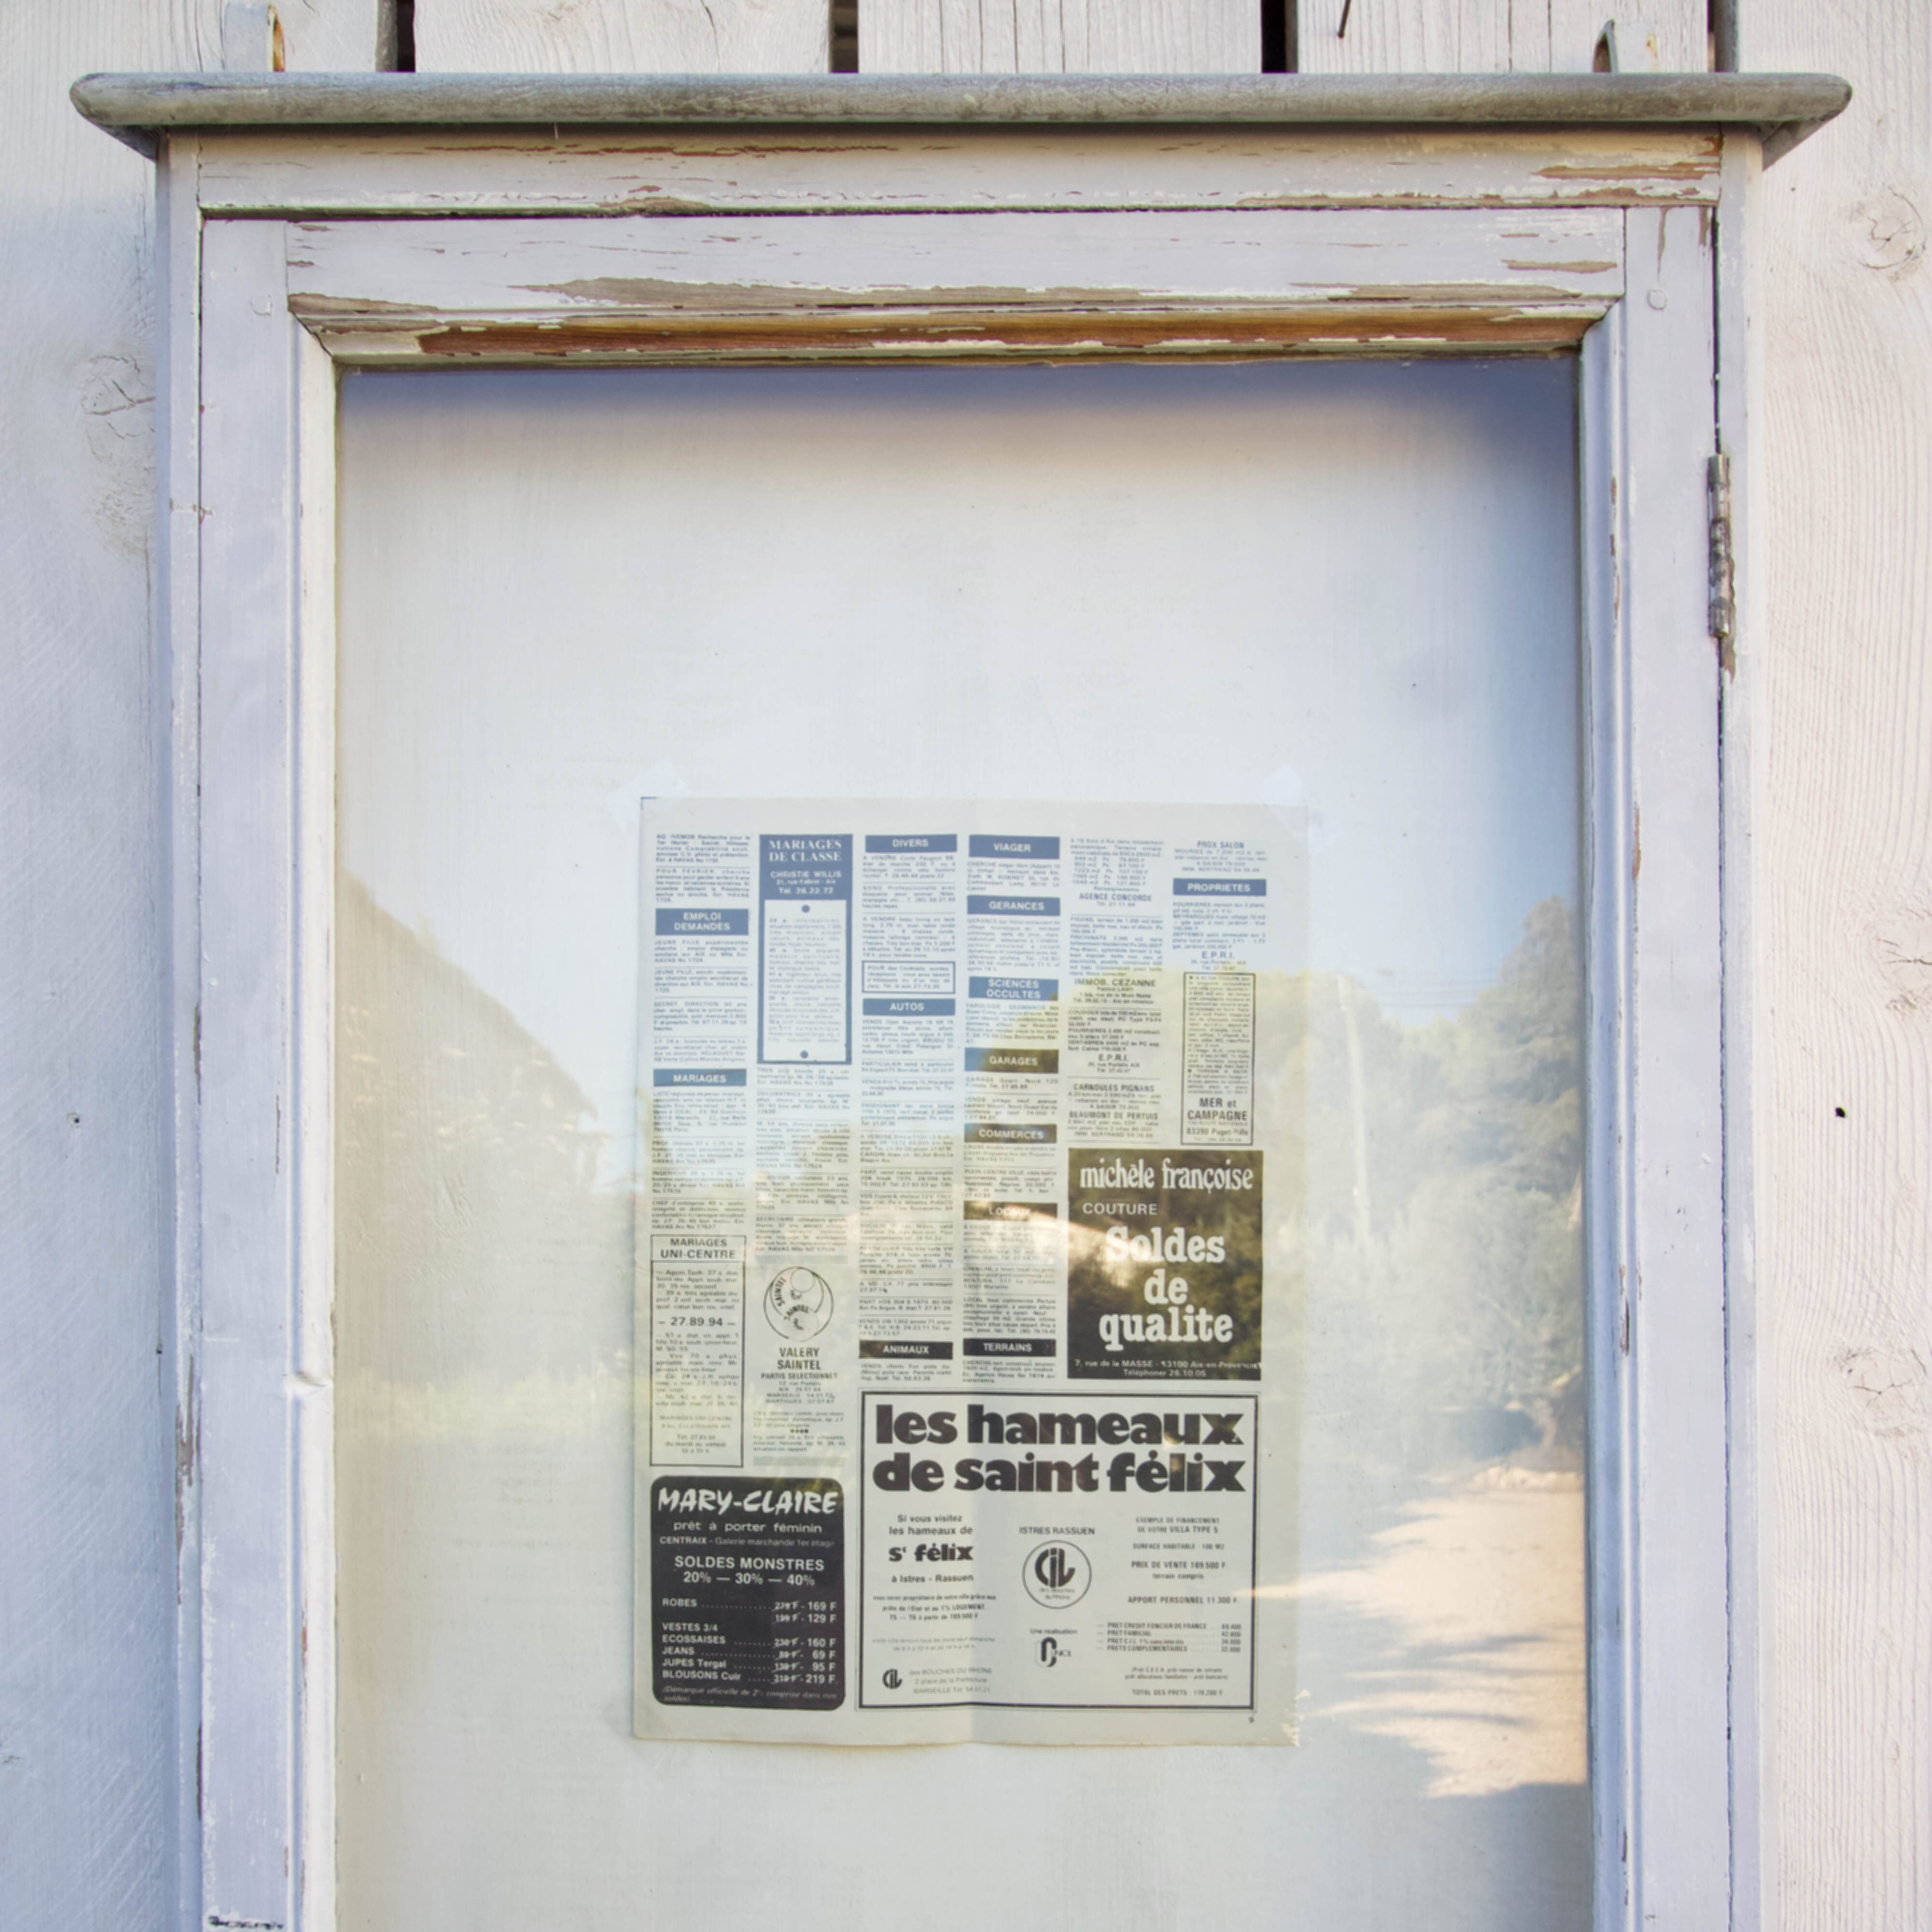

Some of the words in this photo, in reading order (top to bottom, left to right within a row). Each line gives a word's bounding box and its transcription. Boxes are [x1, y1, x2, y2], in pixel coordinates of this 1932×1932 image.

[769, 839, 842, 850] MARIAGES
[892, 839, 928, 848] DIVERS
[994, 843, 1031, 852] VIAGER
[769, 852, 788, 862] DE
[791, 851, 842, 862] CLASSE
[1187, 883, 1250, 893] PROPRIETES
[989, 901, 1044, 910] GERANCES
[683, 912, 722, 921] EMPLOI
[674, 922, 730, 931] DEMANDES
[988, 979, 1039, 989] SCIENCES
[1112, 979, 1156, 987] CEZANNE
[986, 989, 1041, 999] OCCULTES
[890, 1002, 924, 1011] AUTOS
[989, 1055, 1038, 1066] GARAGES
[673, 1074, 726, 1083] MARIAGES
[1199, 1098, 1223, 1108] MER
[1227, 1099, 1236, 1108] et
[1187, 1110, 1248, 1121] CAMPAGNE
[979, 1129, 1044, 1139] COMMERCES
[1080, 1158, 1155, 1188] michèle
[1161, 1157, 1253, 1193] françoise
[1082, 1202, 1158, 1215] COUTURE
[670, 1238, 727, 1247] MARIAGES
[1106, 1225, 1226, 1263] Soldes
[660, 1249, 736, 1259] UNI-CENTRE
[1143, 1268, 1189, 1305] de
[670, 1317, 723, 1327] 27.89.94
[1098, 1304, 1233, 1351] qualite
[883, 1345, 930, 1355] ANIMAUX
[982, 1342, 1032, 1352] TERRAINS
[779, 1347, 820, 1358] VALERY
[777, 1359, 822, 1370] SAINTEL
[876, 1404, 958, 1444] les
[967, 1403, 1245, 1446] hameaux
[872, 1452, 945, 1492] de
[954, 1451, 1099, 1492] saint
[658, 1487, 839, 1515] MARY-CLAIRE
[897, 1514, 907, 1522] Si
[673, 1521, 701, 1531] prêt
[709, 1521, 717, 1531] à
[725, 1522, 766, 1533] porter
[774, 1522, 822, 1533] féminin
[889, 1526, 904, 1535] les
[908, 1526, 955, 1535] hameaux
[960, 1526, 973, 1534] de
[1019, 1526, 1051, 1534] ISTRES
[1052, 1526, 1095, 1535] RASSUEN
[674, 1556, 735, 1569] SOLDES
[740, 1557, 824, 1571] MONSTRES
[683, 1571, 711, 1583] 20%
[735, 1572, 763, 1585] 30%
[787, 1574, 815, 1586] 40%
[662, 1598, 697, 1607] ROBES
[808, 1601, 826, 1611] 169
[829, 1602, 837, 1611] F
[808, 1614, 826, 1623] 129
[829, 1614, 837, 1623] F
[662, 1622, 700, 1632] VESTES
[703, 1623, 718, 1632] 3/4
[662, 1634, 726, 1644] ECOSSAISES
[808, 1638, 825, 1647] 160
[829, 1638, 836, 1647] F
[662, 1647, 695, 1655] JEANS
[812, 1650, 825, 1660] 69
[829, 1650, 836, 1660] F
[662, 1659, 694, 1667] JUPES
[698, 1660, 726, 1669] Tergal
[812, 1662, 825, 1671] 95
[829, 1662, 836, 1672] F
[662, 1670, 718, 1680] BLOUSONS
[721, 1672, 741, 1681] Cuir
[806, 1675, 824, 1684] 219
